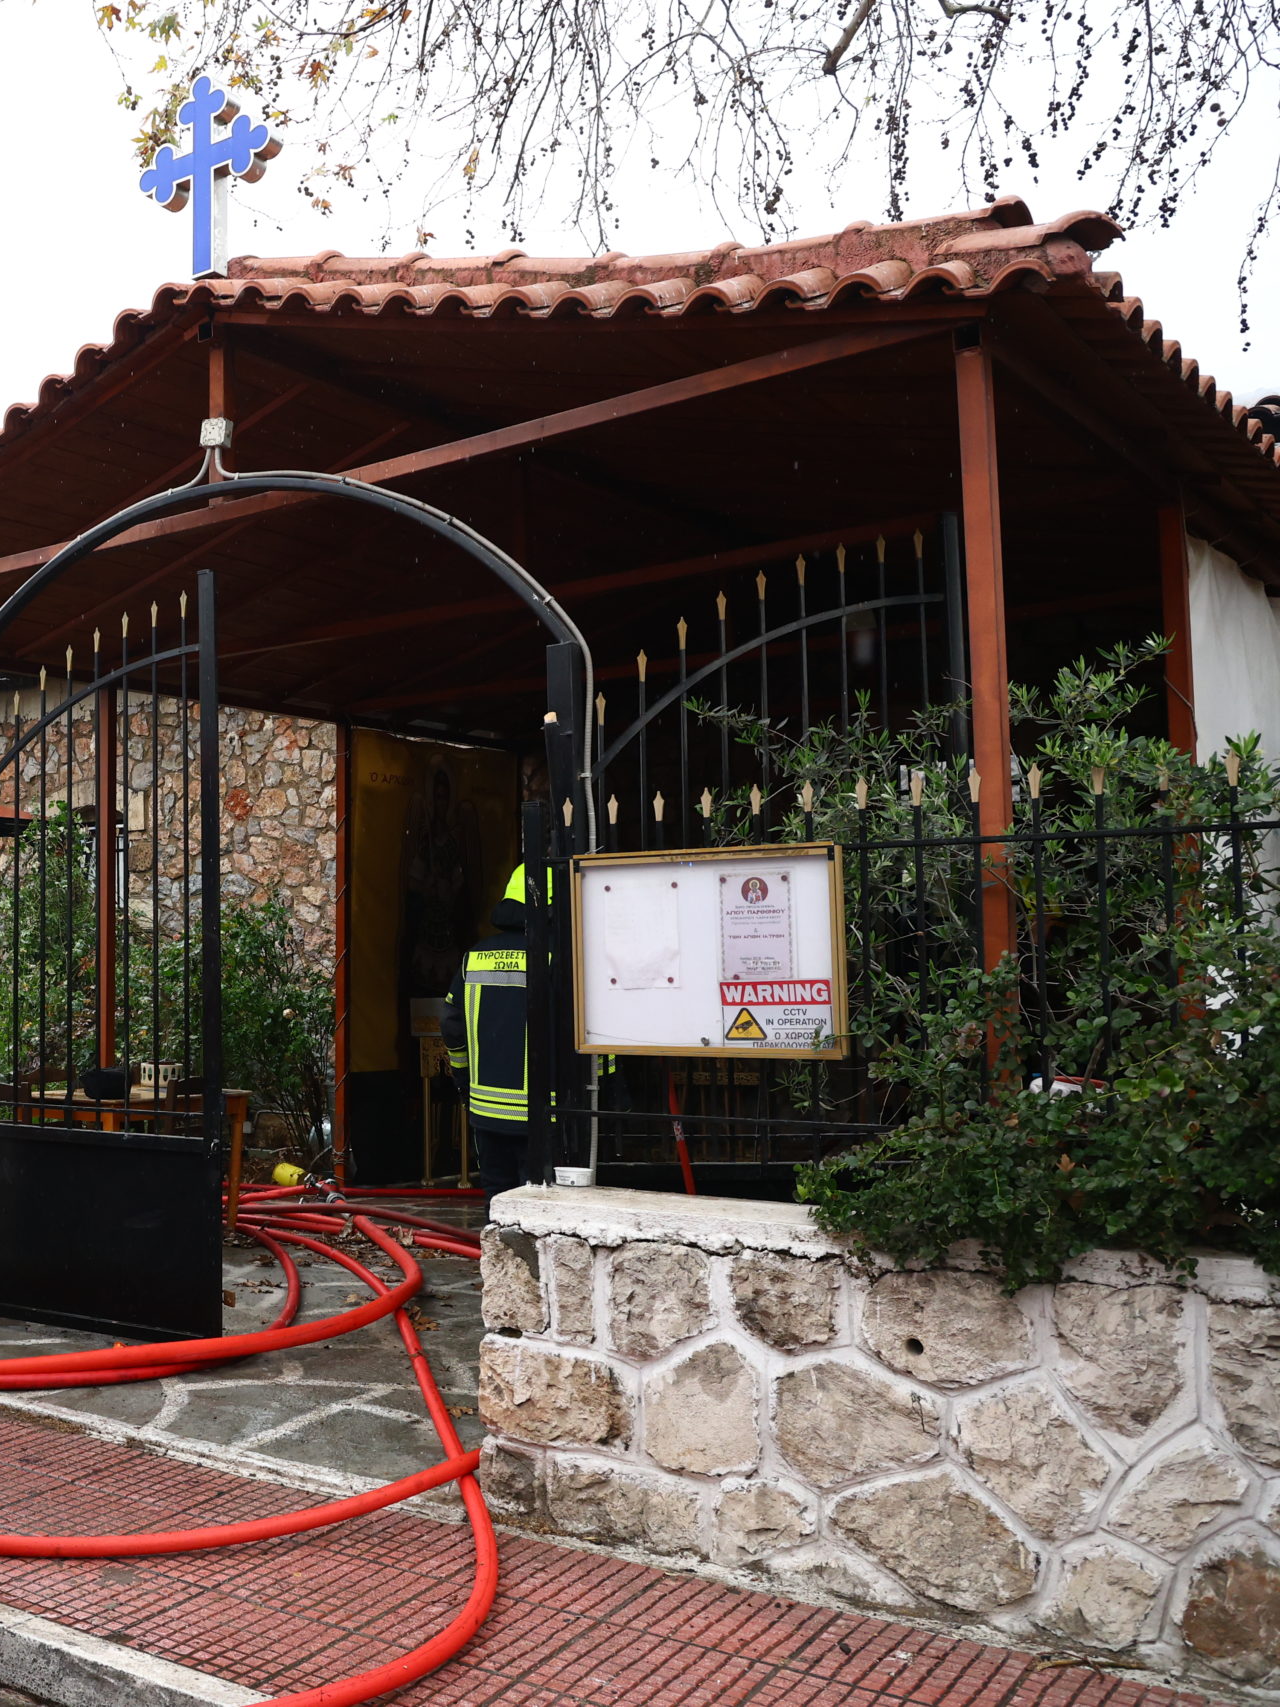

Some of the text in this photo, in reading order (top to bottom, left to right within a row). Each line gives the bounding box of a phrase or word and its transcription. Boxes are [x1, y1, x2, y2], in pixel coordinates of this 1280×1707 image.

[493, 961, 520, 970] ΣΩΜΑ
[722, 982, 829, 1003] WARNING
[783, 1008, 807, 1016] CCTV
[765, 1018, 827, 1026] IN OPERATION
[785, 1031, 814, 1040] ΧΩΡΟΣ
